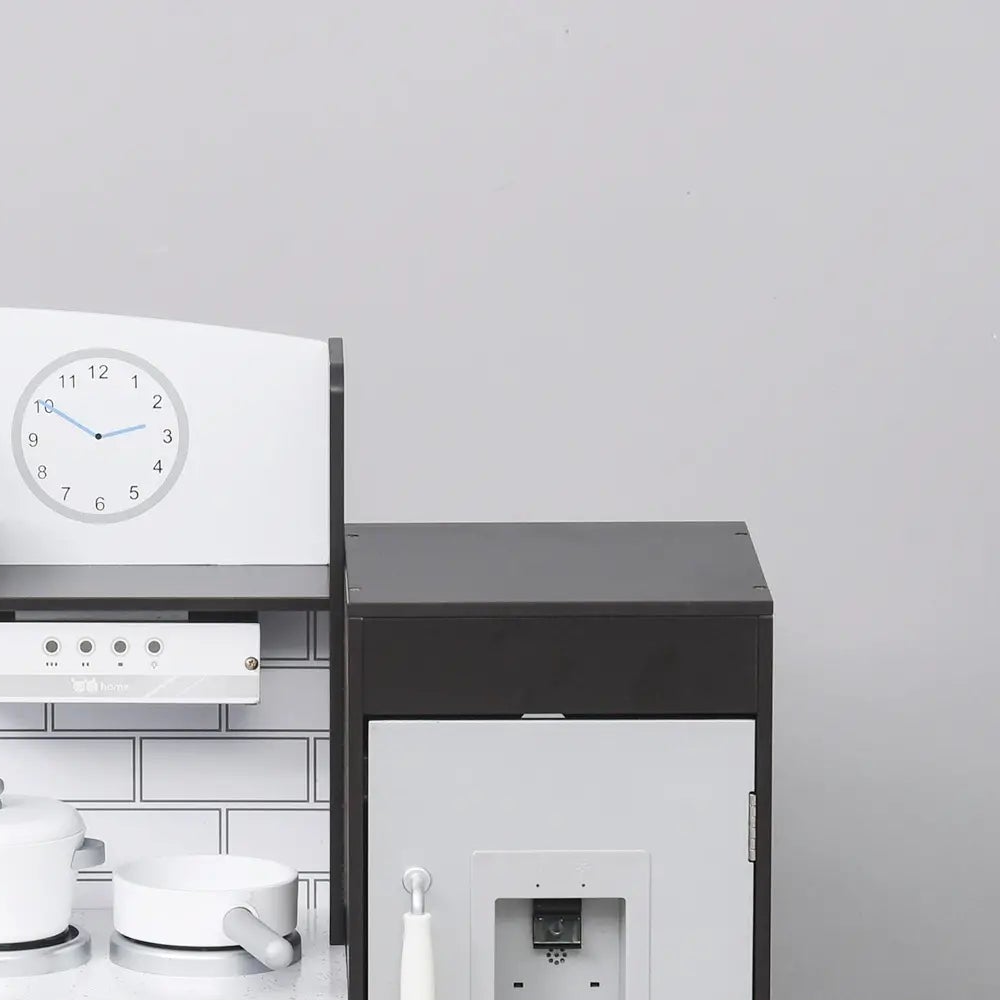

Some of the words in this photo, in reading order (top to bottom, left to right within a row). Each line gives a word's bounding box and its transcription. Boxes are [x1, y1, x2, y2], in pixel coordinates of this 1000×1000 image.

[88, 365, 109, 379] 12
[59, 374, 76, 389] 11
[131, 374, 138, 389] 1
[34, 399, 54, 413] 10
[152, 394, 162, 409] 2
[28, 433, 38, 447] 9
[163, 429, 173, 444] 3
[37, 465, 47, 479] 8
[153, 459, 163, 474] 4
[61, 486, 70, 501] 7
[129, 485, 139, 500] 5
[95, 497, 105, 511] 6
